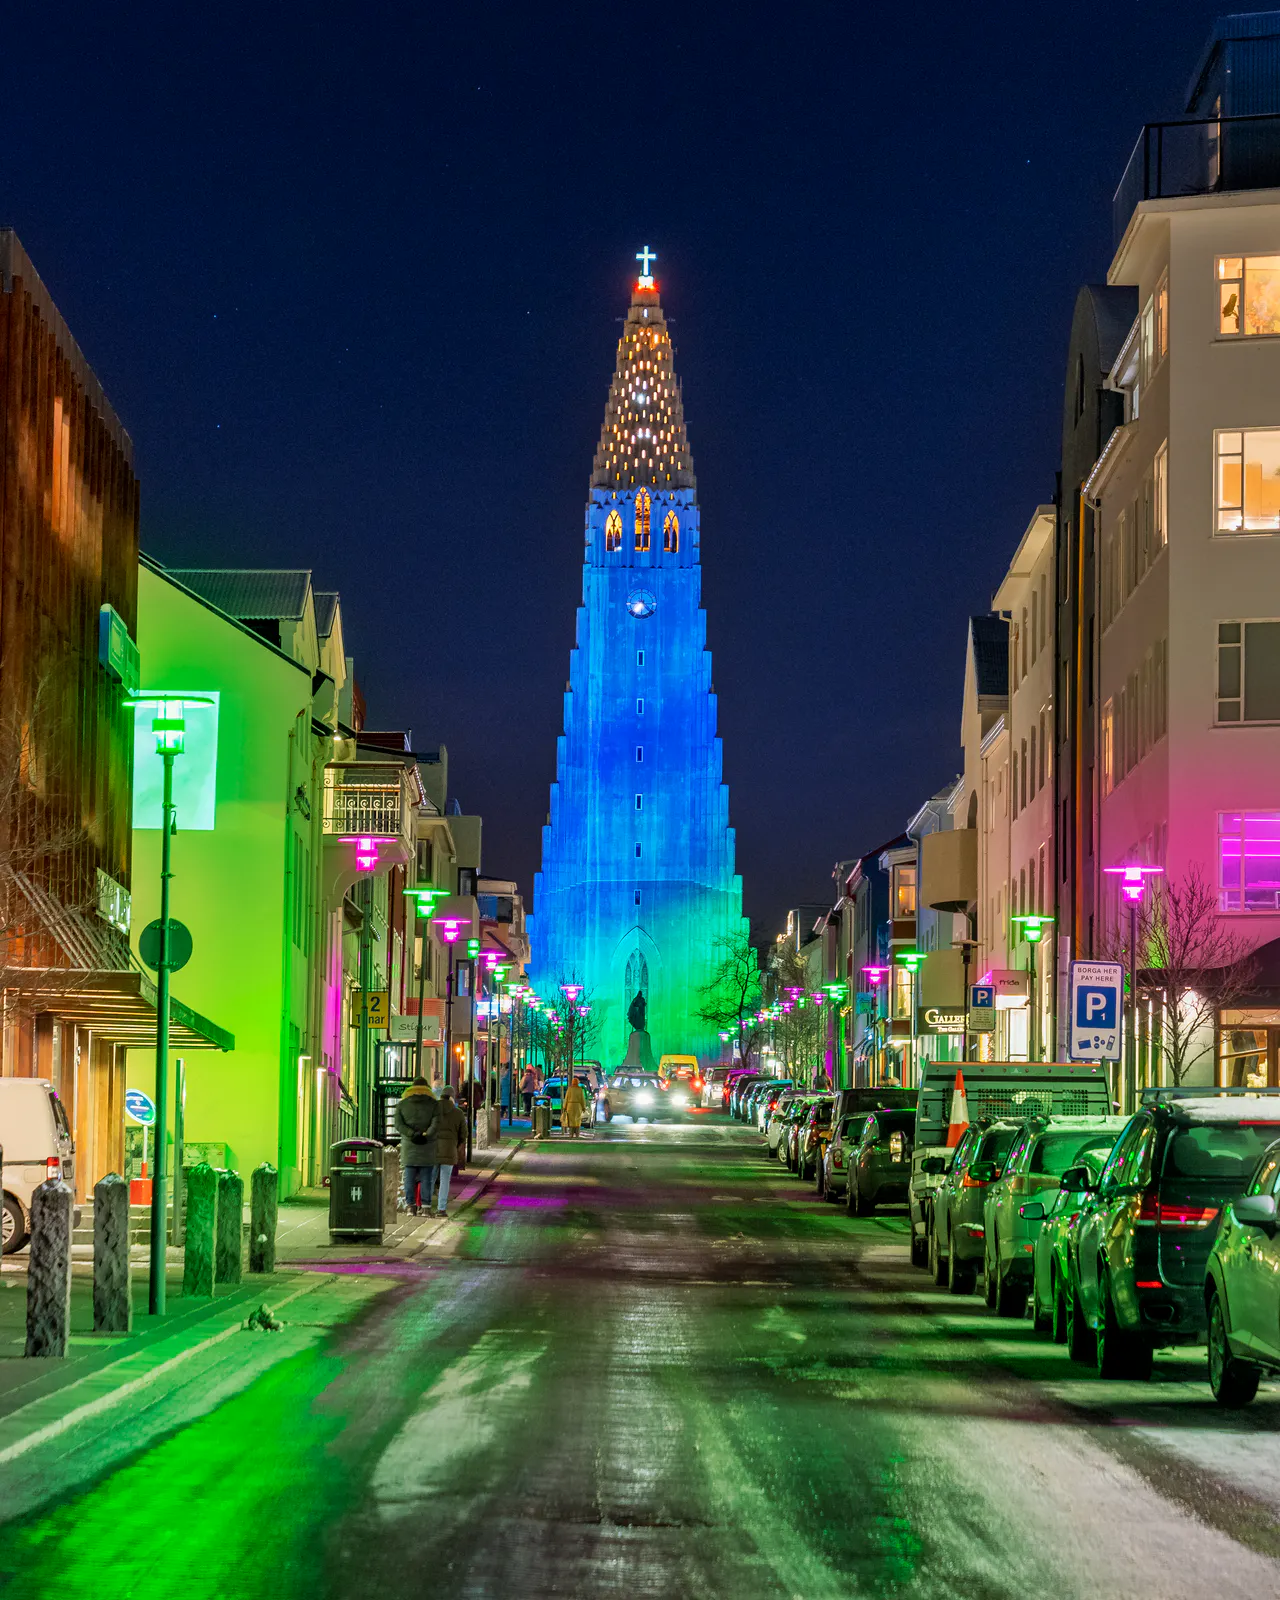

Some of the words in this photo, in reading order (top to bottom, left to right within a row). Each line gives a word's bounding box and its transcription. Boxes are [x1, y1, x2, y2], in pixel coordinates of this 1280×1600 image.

[977, 990, 988, 1004] P
[1086, 992, 1107, 1021] P
[355, 1013, 385, 1024] Tnar
